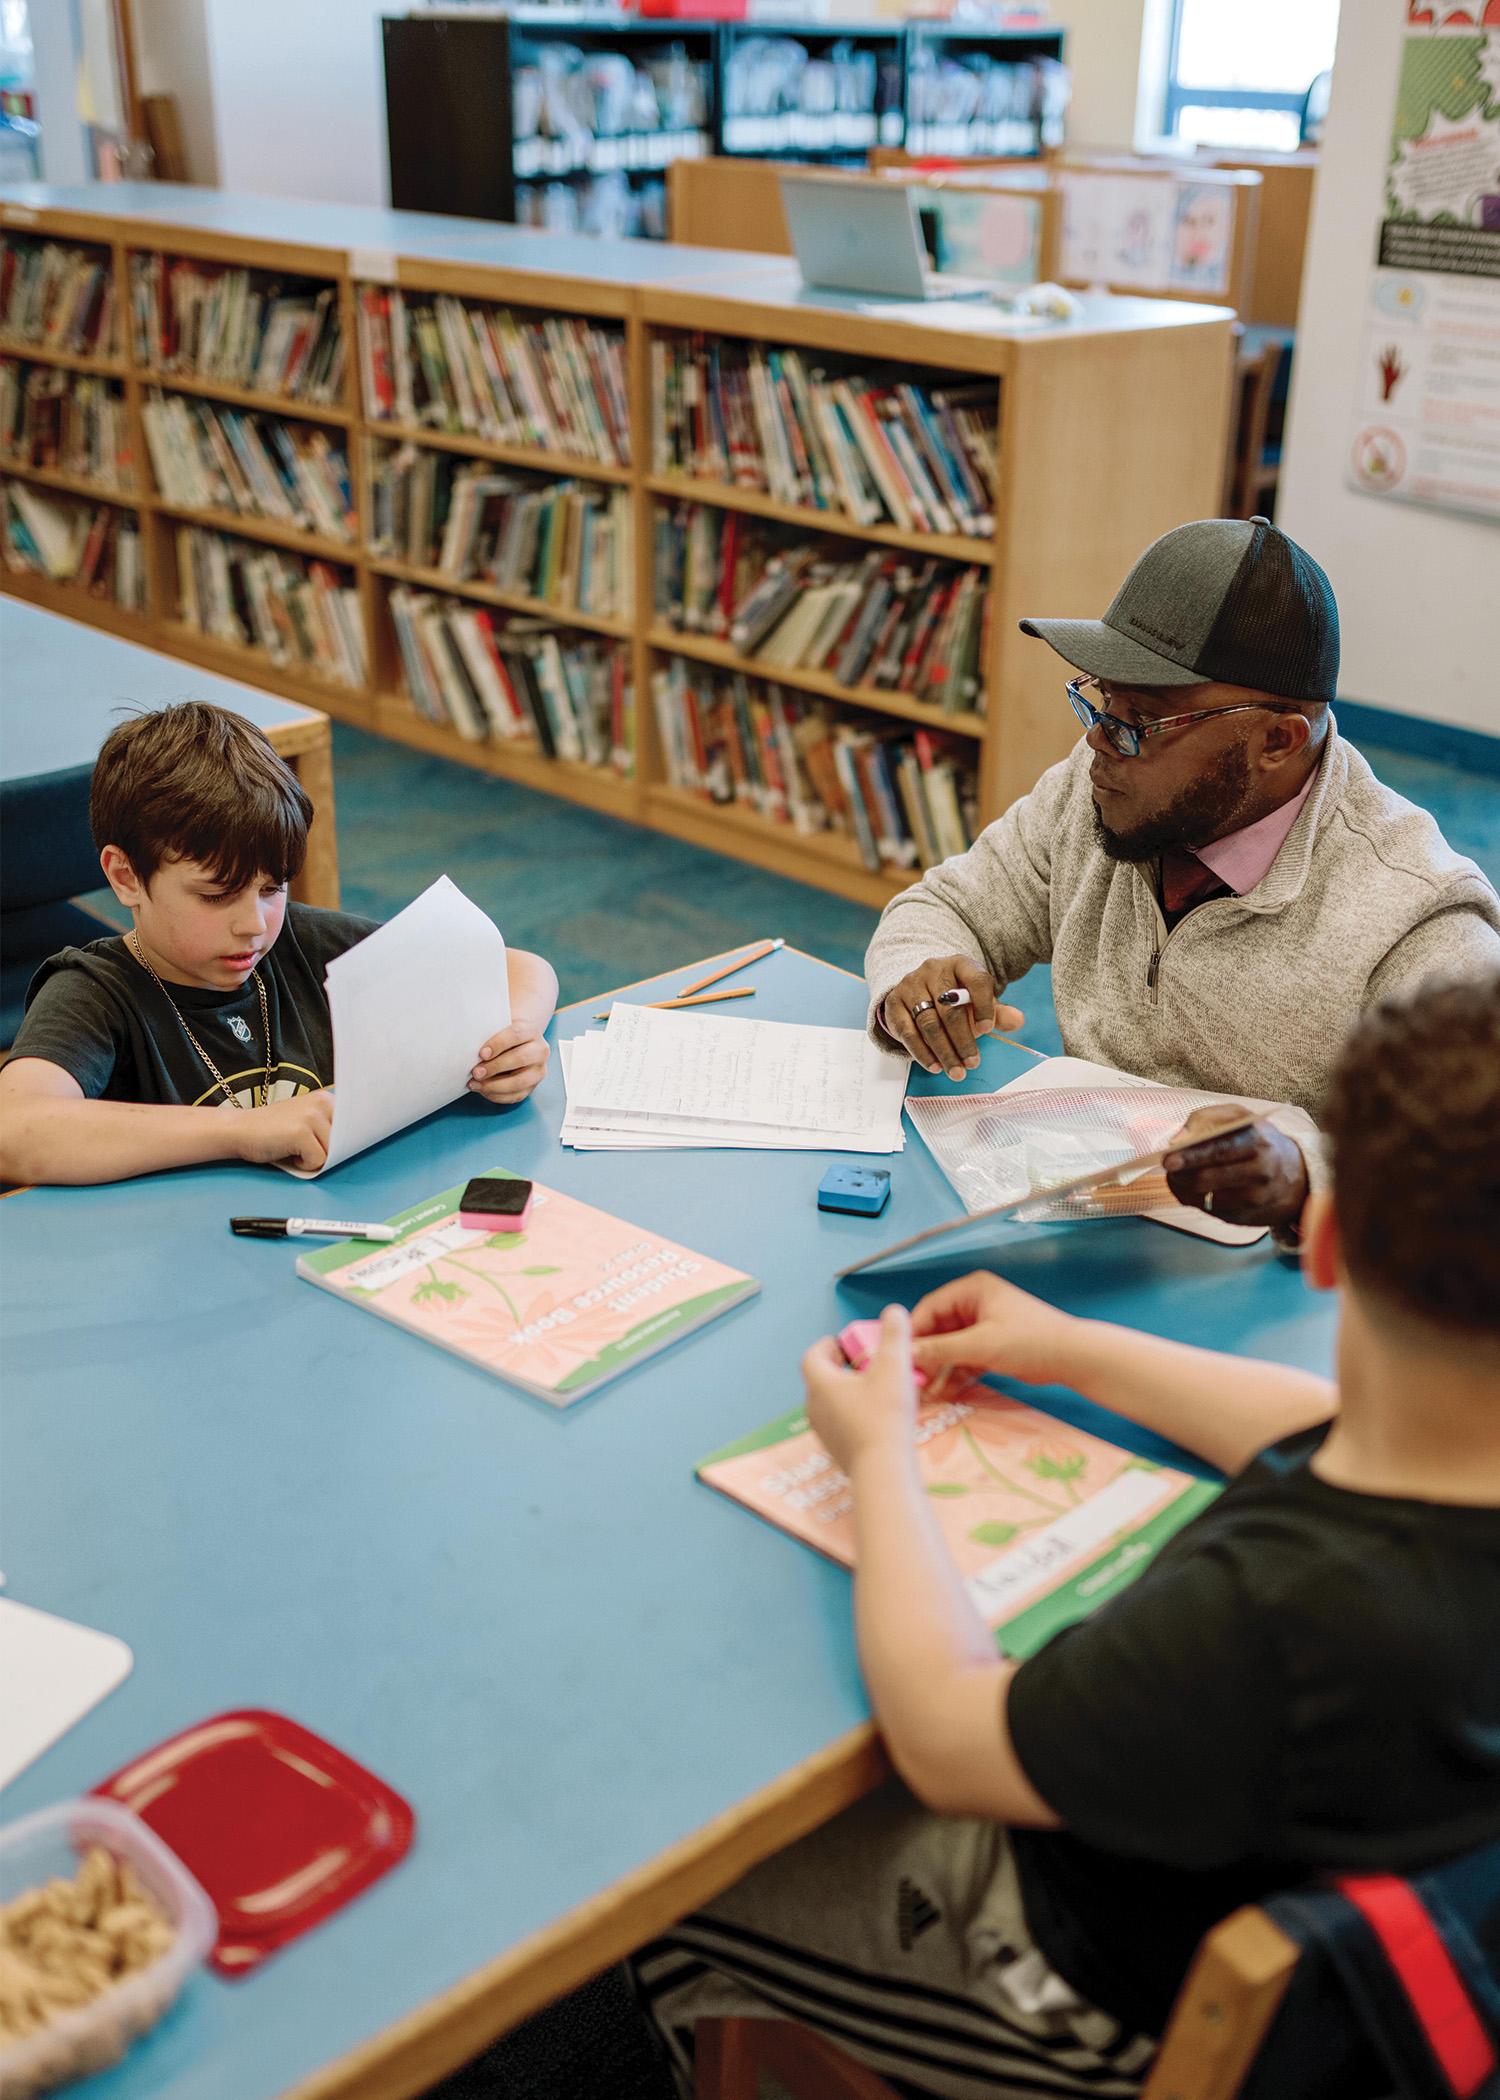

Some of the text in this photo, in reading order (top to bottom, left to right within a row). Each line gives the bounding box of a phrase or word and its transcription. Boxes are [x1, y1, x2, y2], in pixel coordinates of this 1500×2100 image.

[571, 1249, 682, 1310] Resource
[605, 1258, 703, 1314] Student
[506, 1307, 578, 1346] Book
